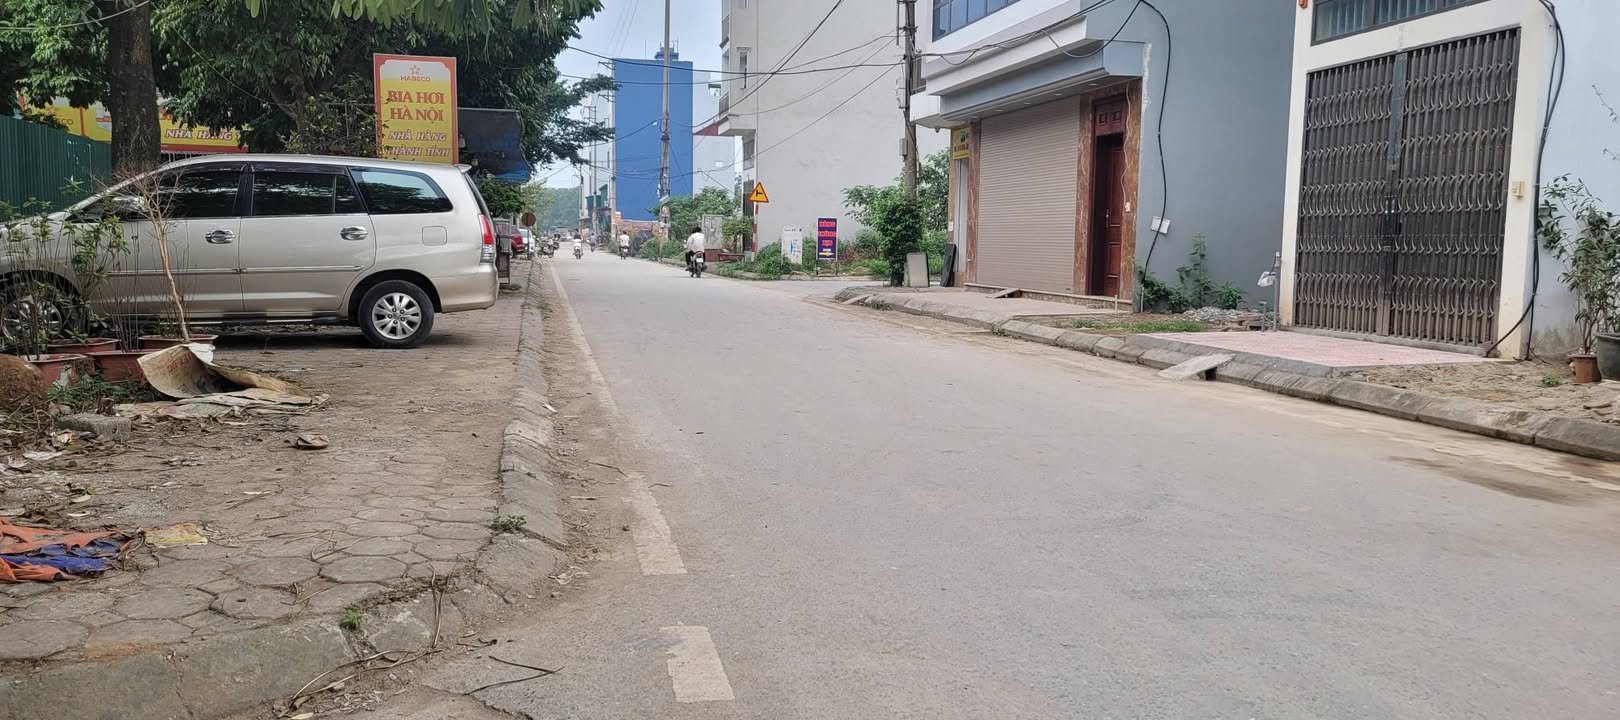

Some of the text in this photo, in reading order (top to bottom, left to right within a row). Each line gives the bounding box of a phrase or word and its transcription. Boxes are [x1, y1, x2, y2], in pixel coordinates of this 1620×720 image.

[387, 90, 445, 104] BIA HƠI
[390, 105, 444, 124] HÀ NỘI
[388, 129, 447, 142] NHÀ HÀNG
